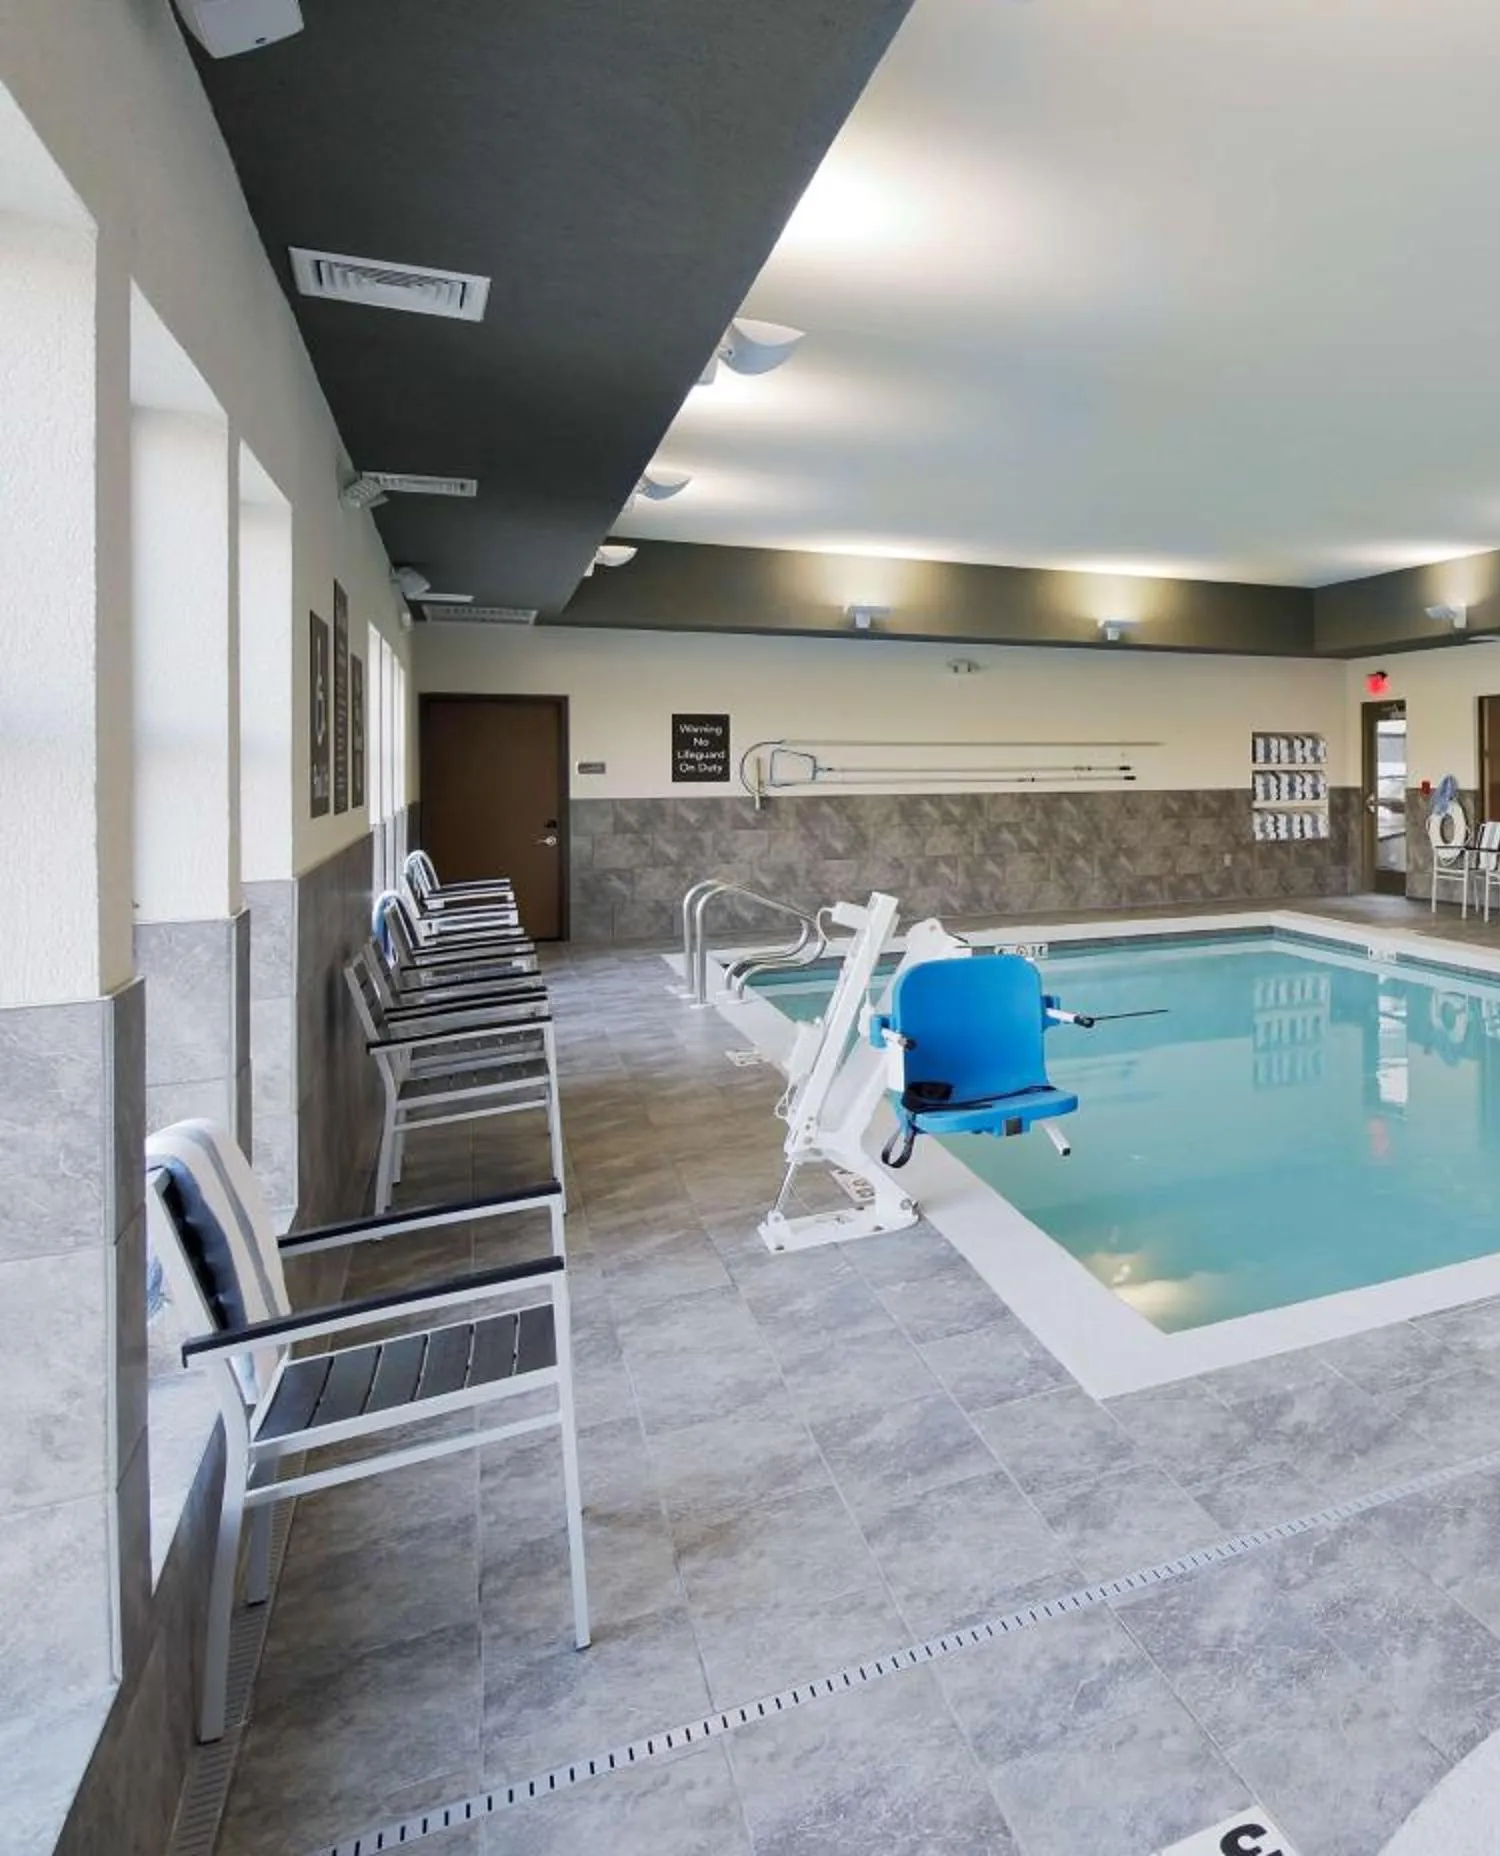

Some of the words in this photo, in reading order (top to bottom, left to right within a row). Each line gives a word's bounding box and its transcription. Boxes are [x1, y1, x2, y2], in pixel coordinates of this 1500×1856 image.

[679, 723, 722, 736] Warning
[693, 737, 709, 747] No
[677, 750, 725, 761] Lifeguard
[679, 763, 695, 773] On
[697, 763, 722, 774] Duty
